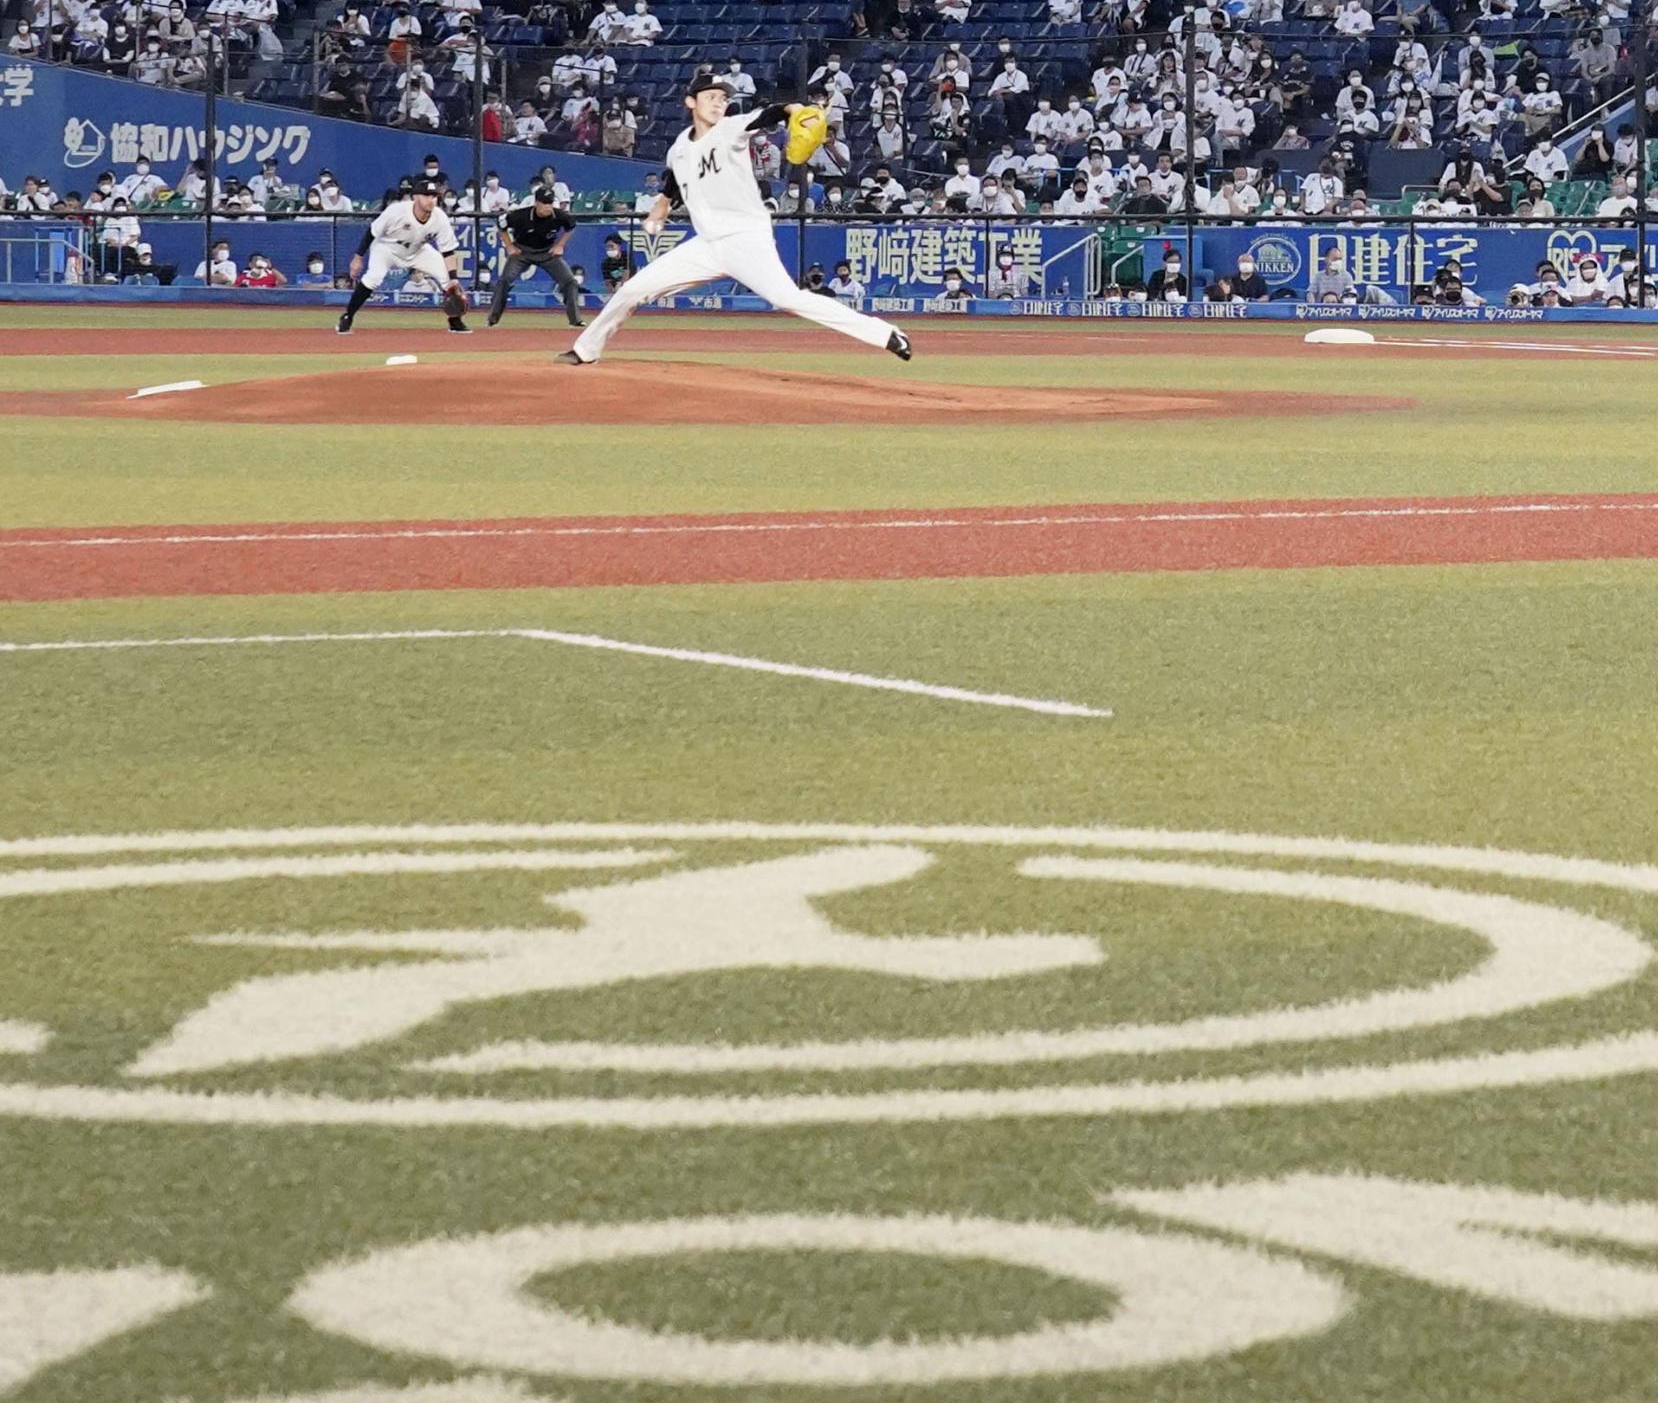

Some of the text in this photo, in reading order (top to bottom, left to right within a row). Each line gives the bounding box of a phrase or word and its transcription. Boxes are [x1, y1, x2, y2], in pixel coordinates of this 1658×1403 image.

[698, 148, 722, 179] M
[1254, 262, 1294, 273] NIKKEN
[1309, 233, 1478, 286] 日建住宅
